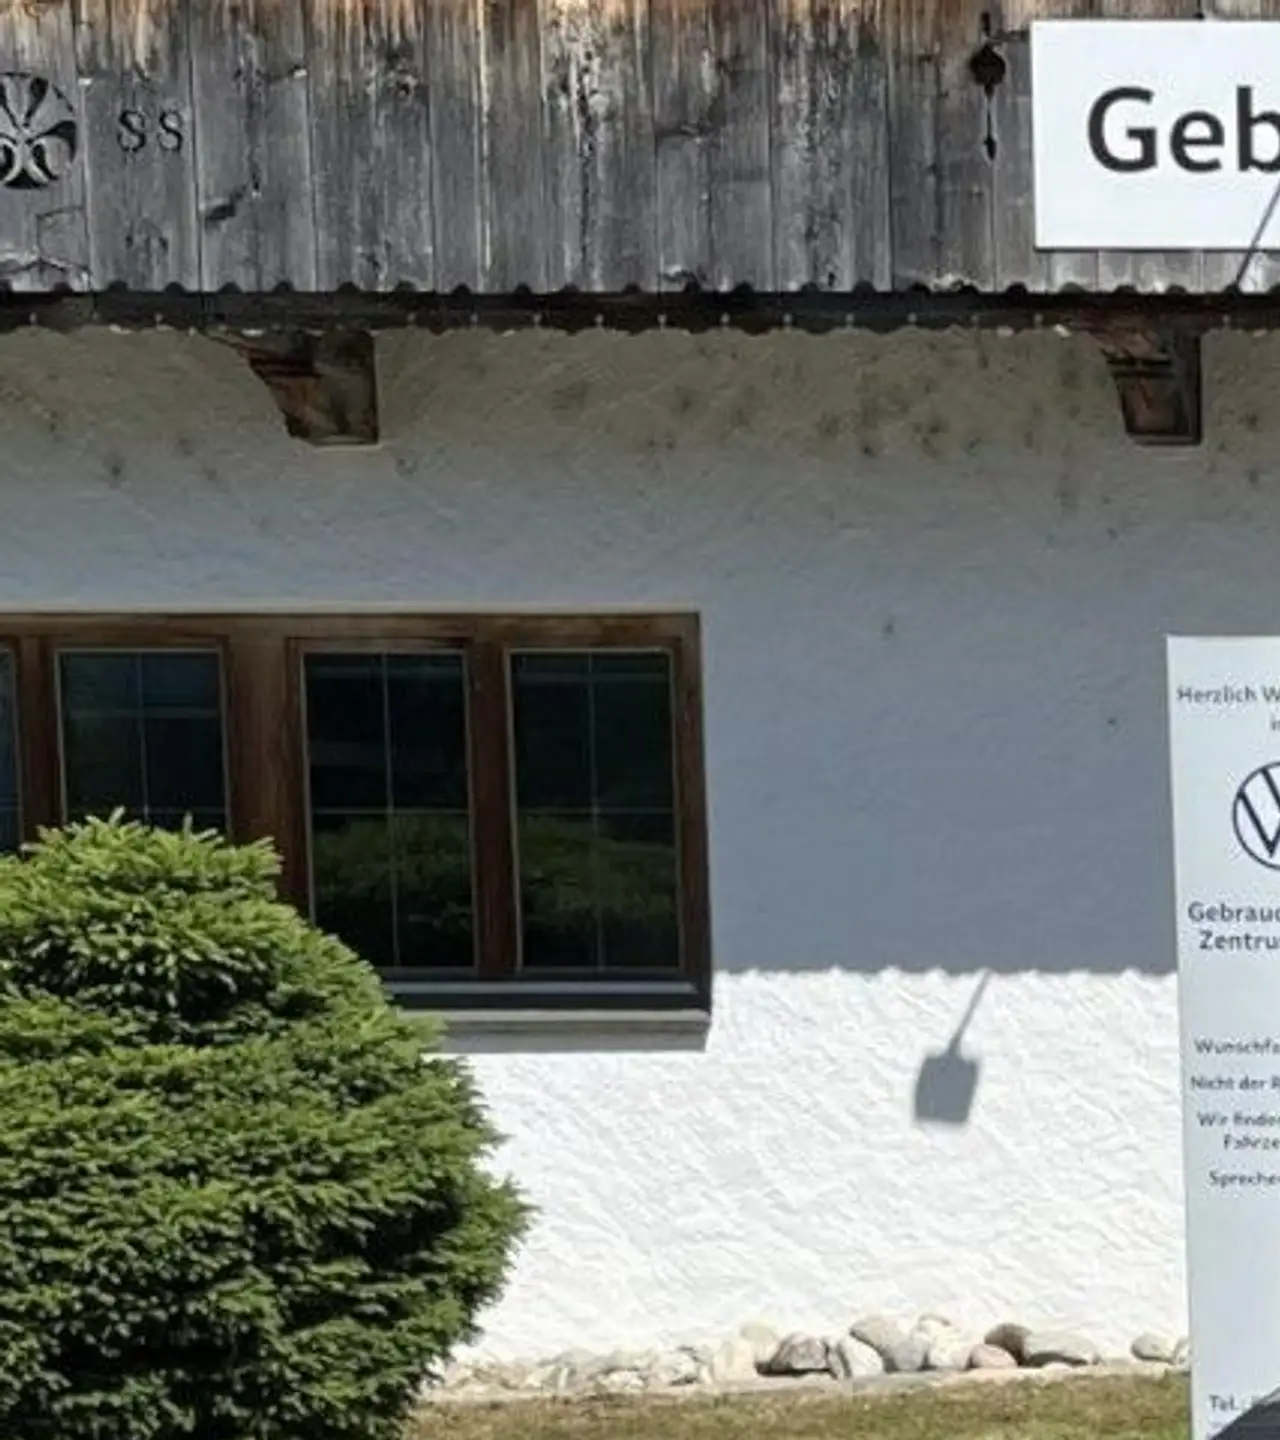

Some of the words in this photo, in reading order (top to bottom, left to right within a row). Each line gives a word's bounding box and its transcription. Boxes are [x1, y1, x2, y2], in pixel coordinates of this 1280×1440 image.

[1176, 684, 1257, 703] Herzlich
[1191, 1075, 1234, 1090] Nicht
[1240, 1075, 1266, 1090] der
[1197, 1112, 1228, 1127] Wir
